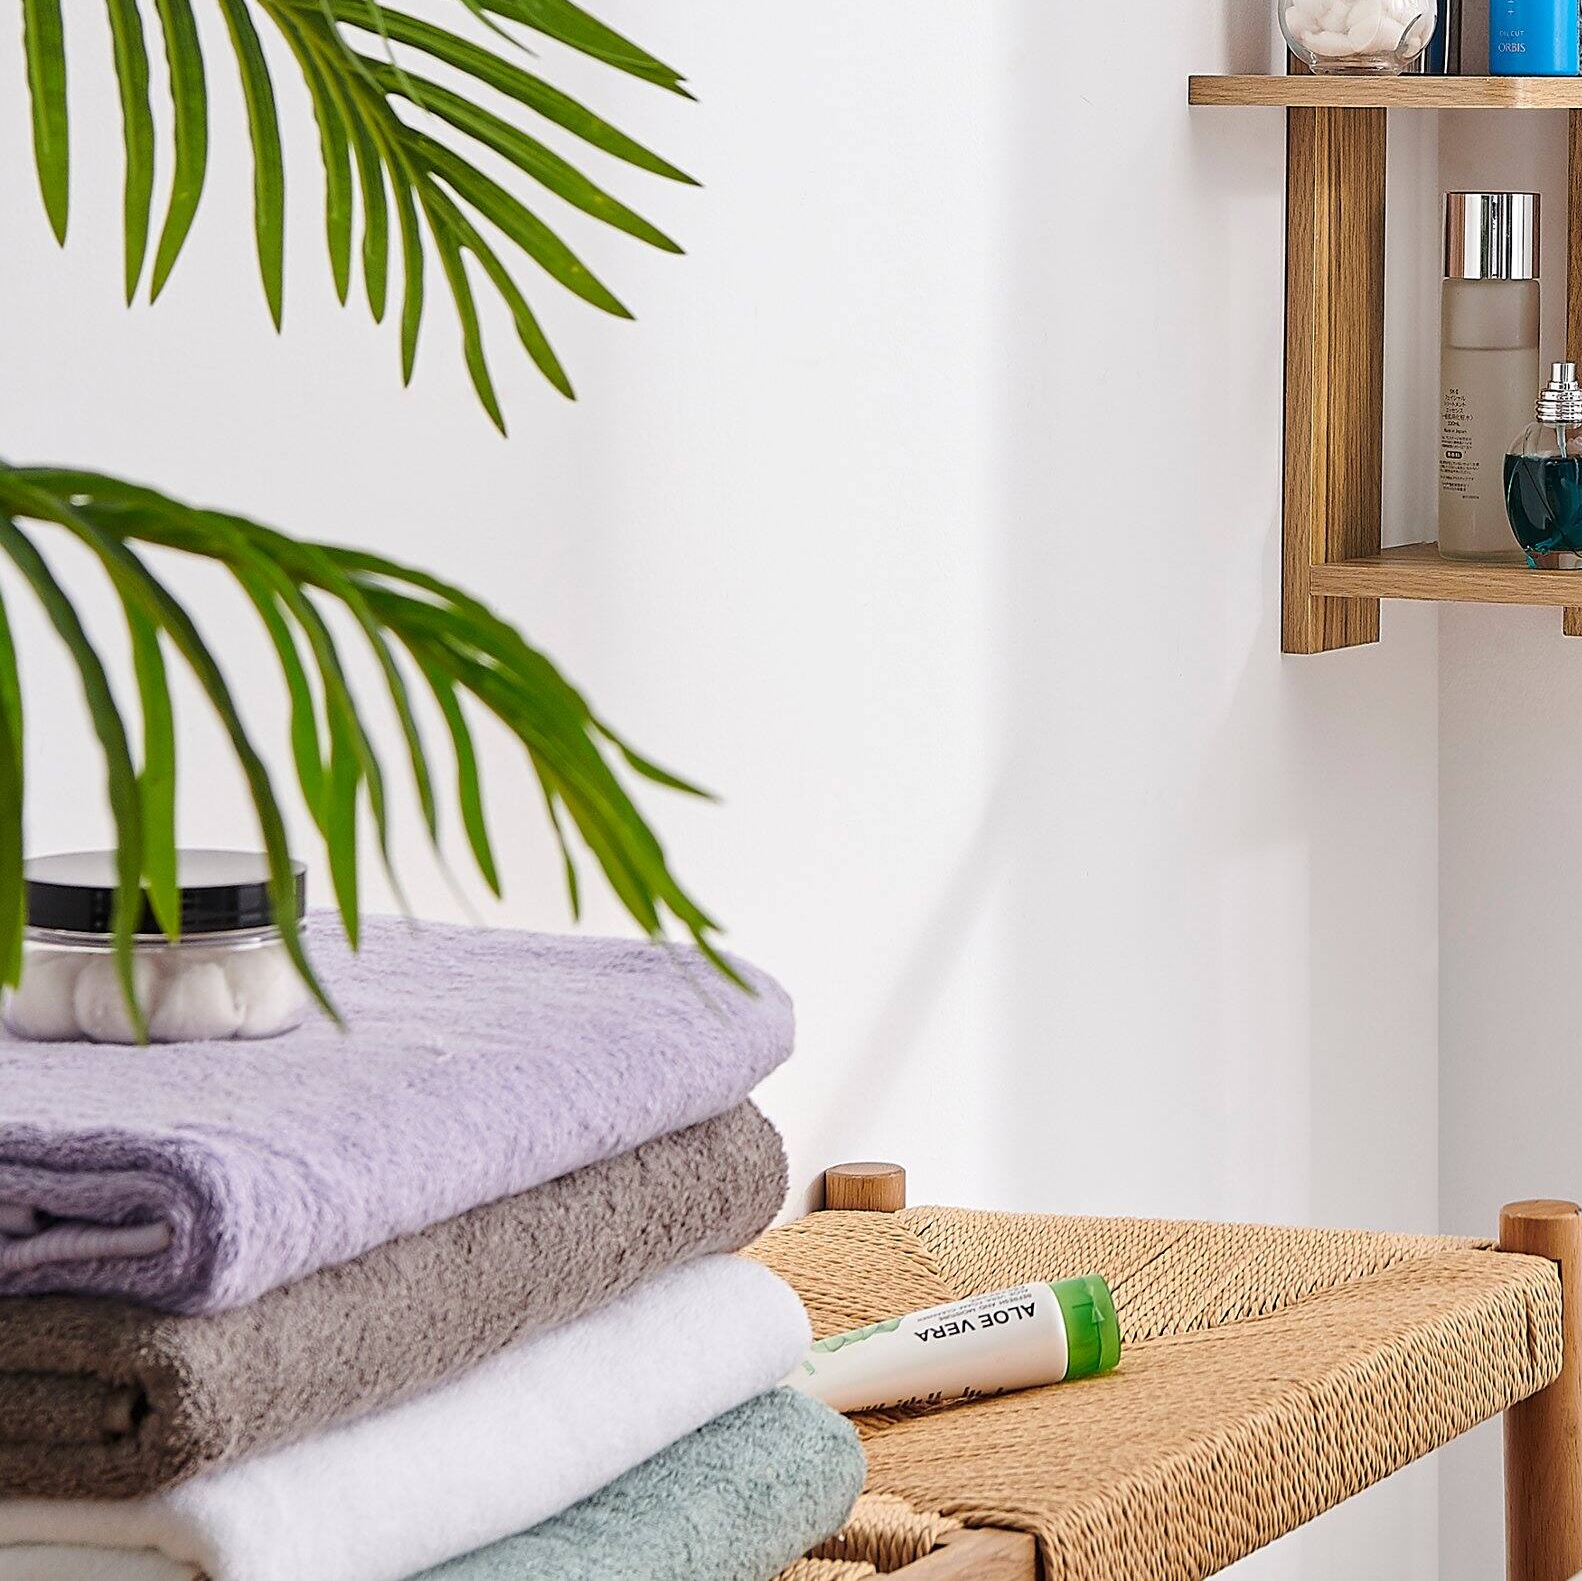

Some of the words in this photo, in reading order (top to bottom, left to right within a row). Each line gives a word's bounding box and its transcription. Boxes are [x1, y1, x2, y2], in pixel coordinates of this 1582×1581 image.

[1498, 42, 1526, 52] ORBIS
[978, 1302, 1035, 1328] ALOE
[914, 1320, 976, 1342] VERA
